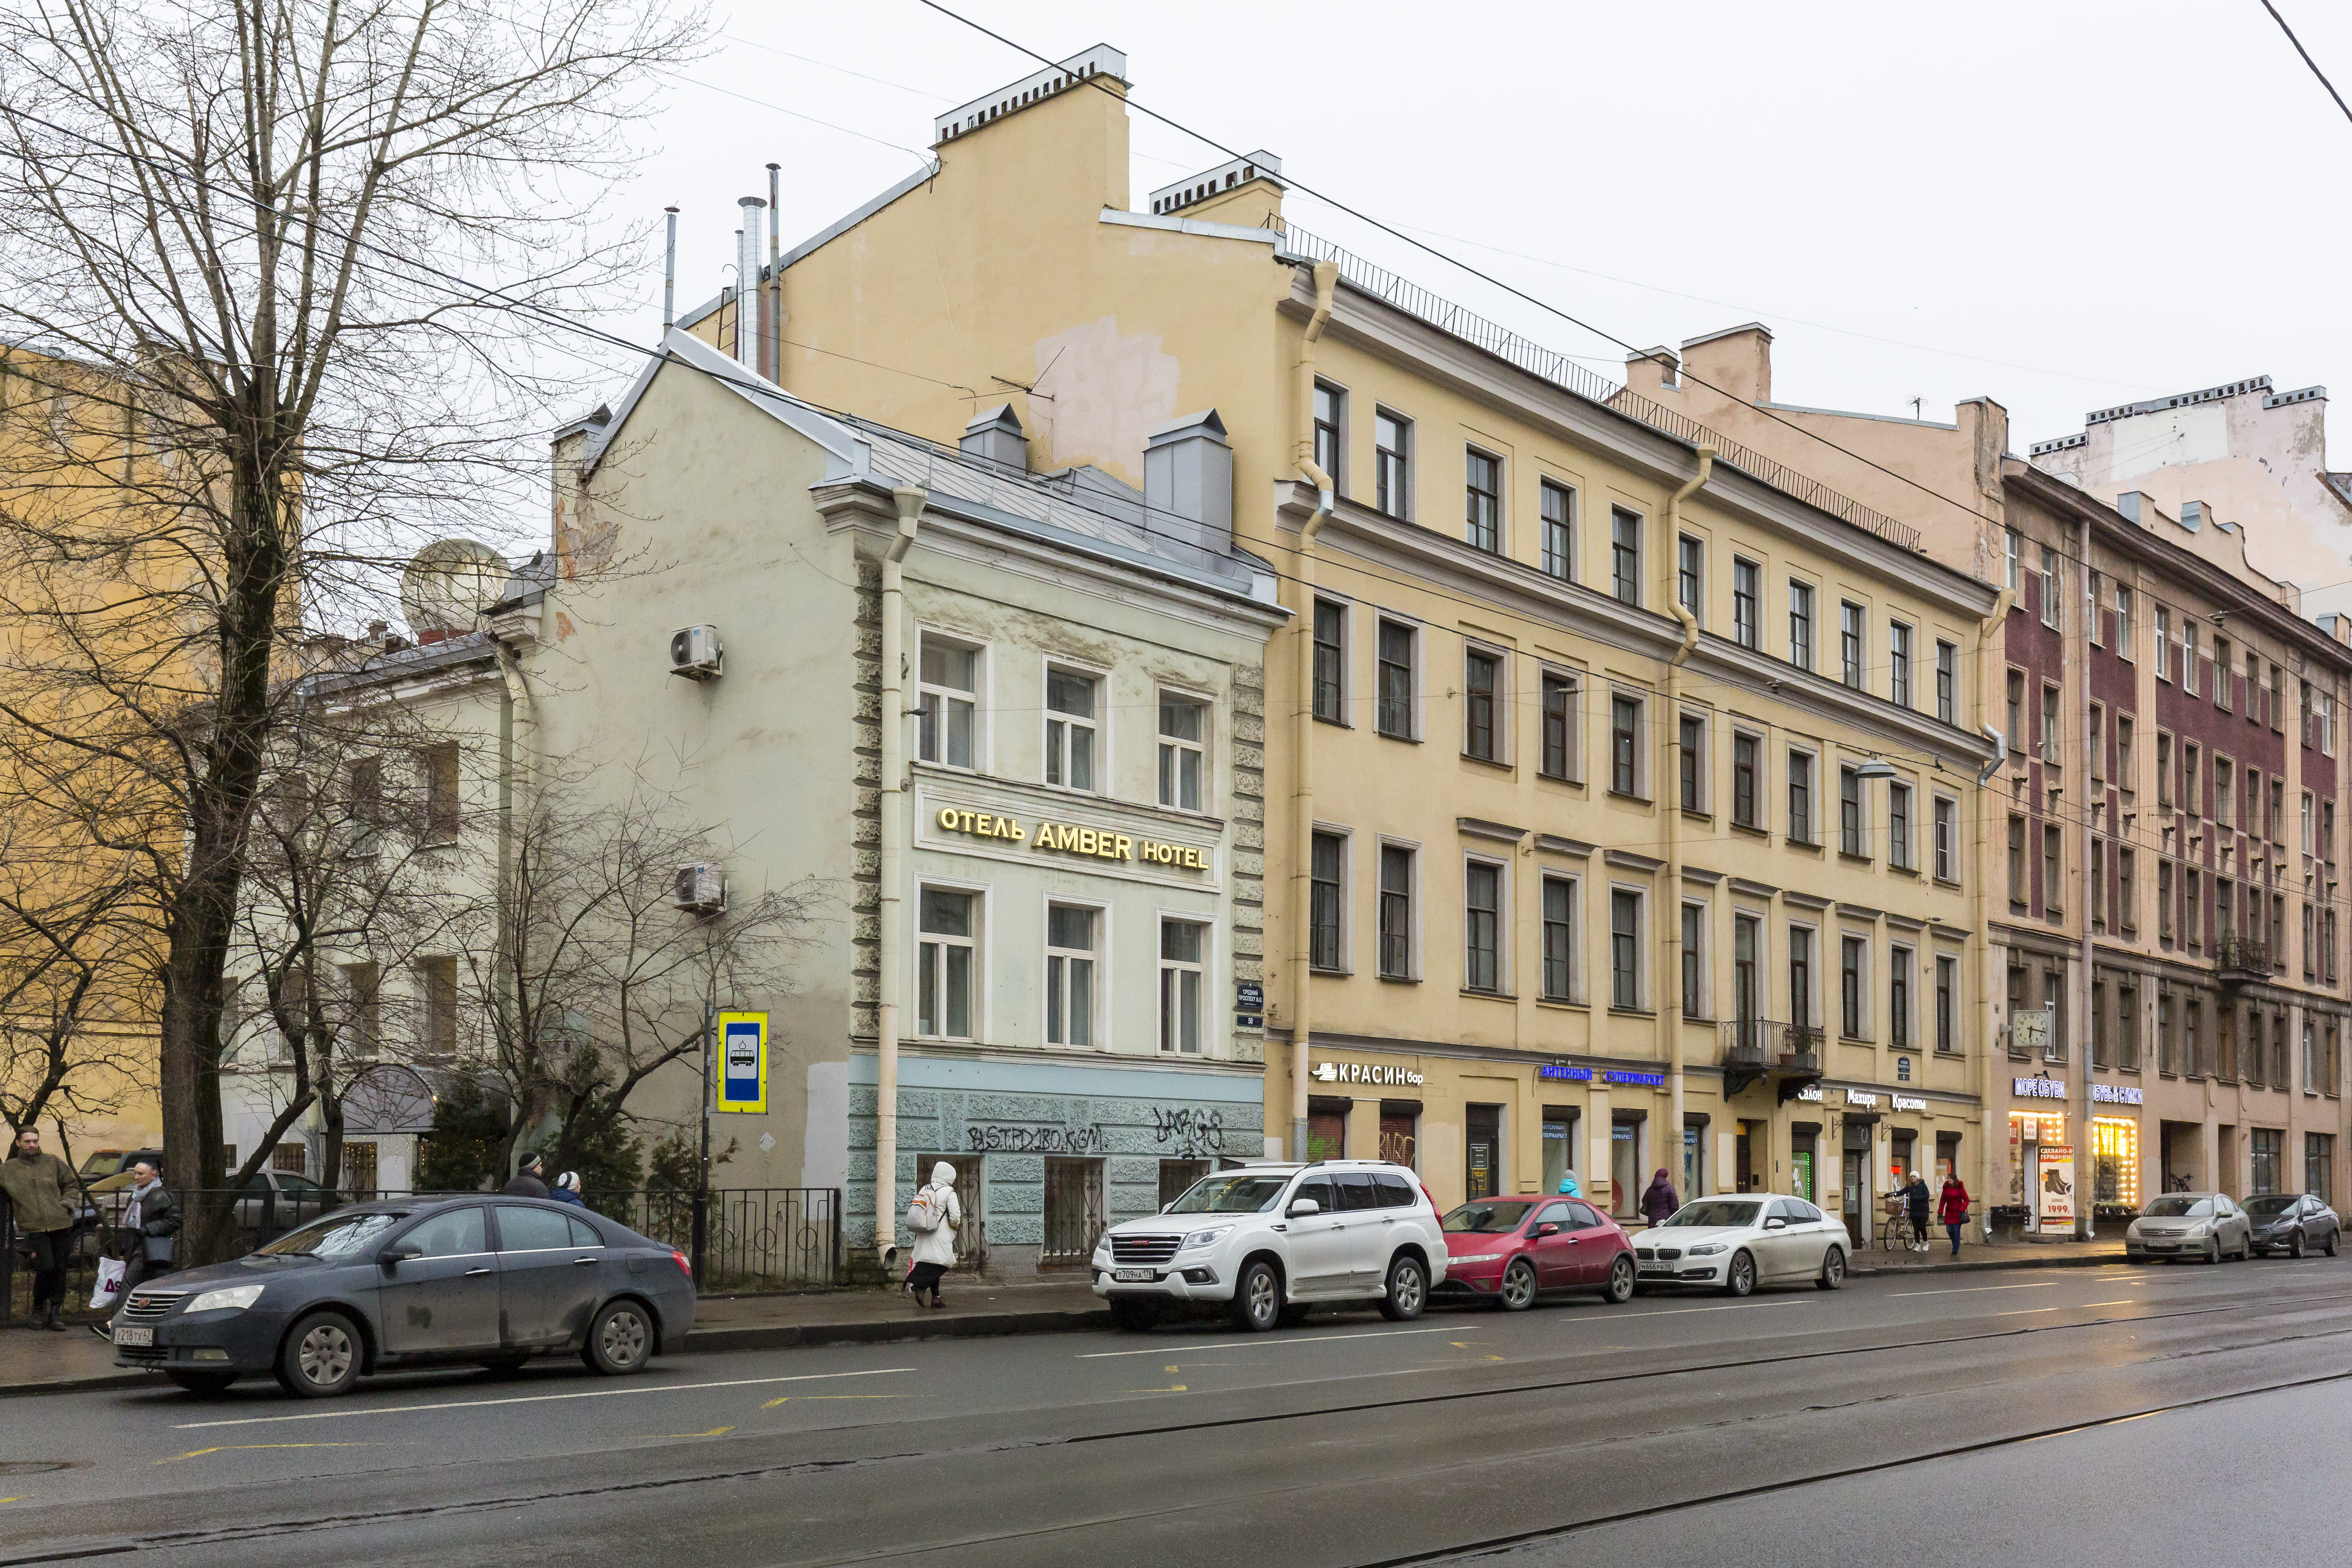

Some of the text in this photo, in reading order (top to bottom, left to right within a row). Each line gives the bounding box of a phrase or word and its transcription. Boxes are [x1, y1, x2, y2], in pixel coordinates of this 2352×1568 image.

[940, 807, 1209, 870] ОТЕЛЬ AMBER HOTEL
[1339, 1063, 1423, 1086] КРАСИН бар
[1542, 1065, 1664, 1086] АНТЕННЫЙ СУПЕРМАРКЕТ
[2015, 1078, 2065, 1098] МОРЕ ОБУВИ
[2119, 1087, 2143, 1105] СУМКИ
[1798, 1089, 1926, 1111] Салон Махира Красоты
[1118, 1270, 1142, 1278] Т709НА
